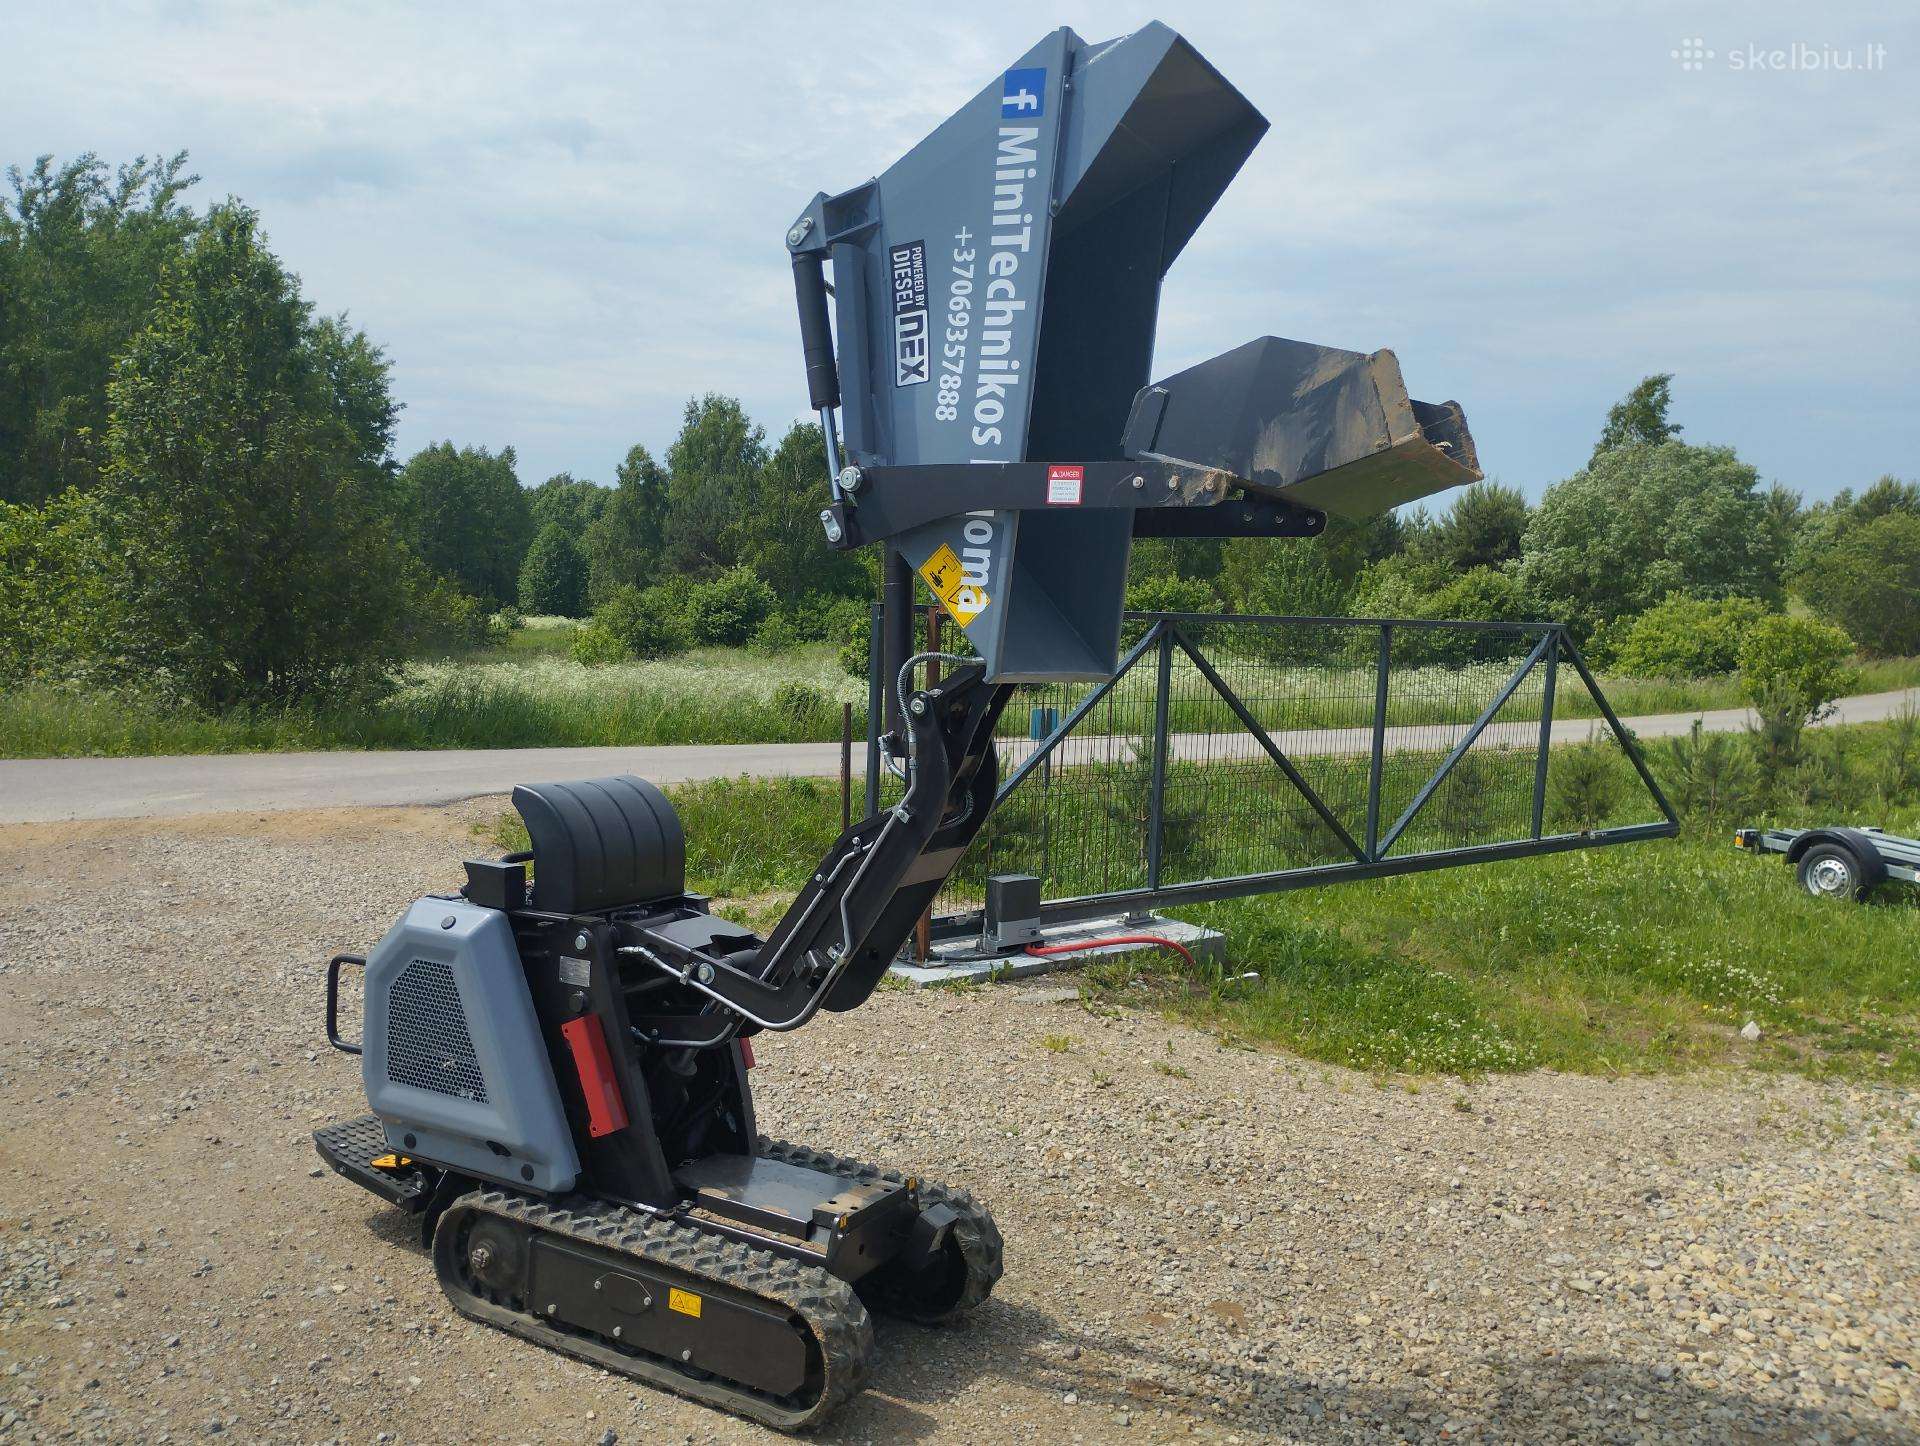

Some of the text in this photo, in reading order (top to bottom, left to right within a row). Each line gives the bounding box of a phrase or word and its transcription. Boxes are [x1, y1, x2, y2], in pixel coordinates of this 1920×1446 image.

[893, 250, 913, 311] DIESEL
[912, 246, 925, 306] POWERED BY
[935, 226, 976, 421] +37069357888
[972, 127, 1039, 446] MiniTechnikos
